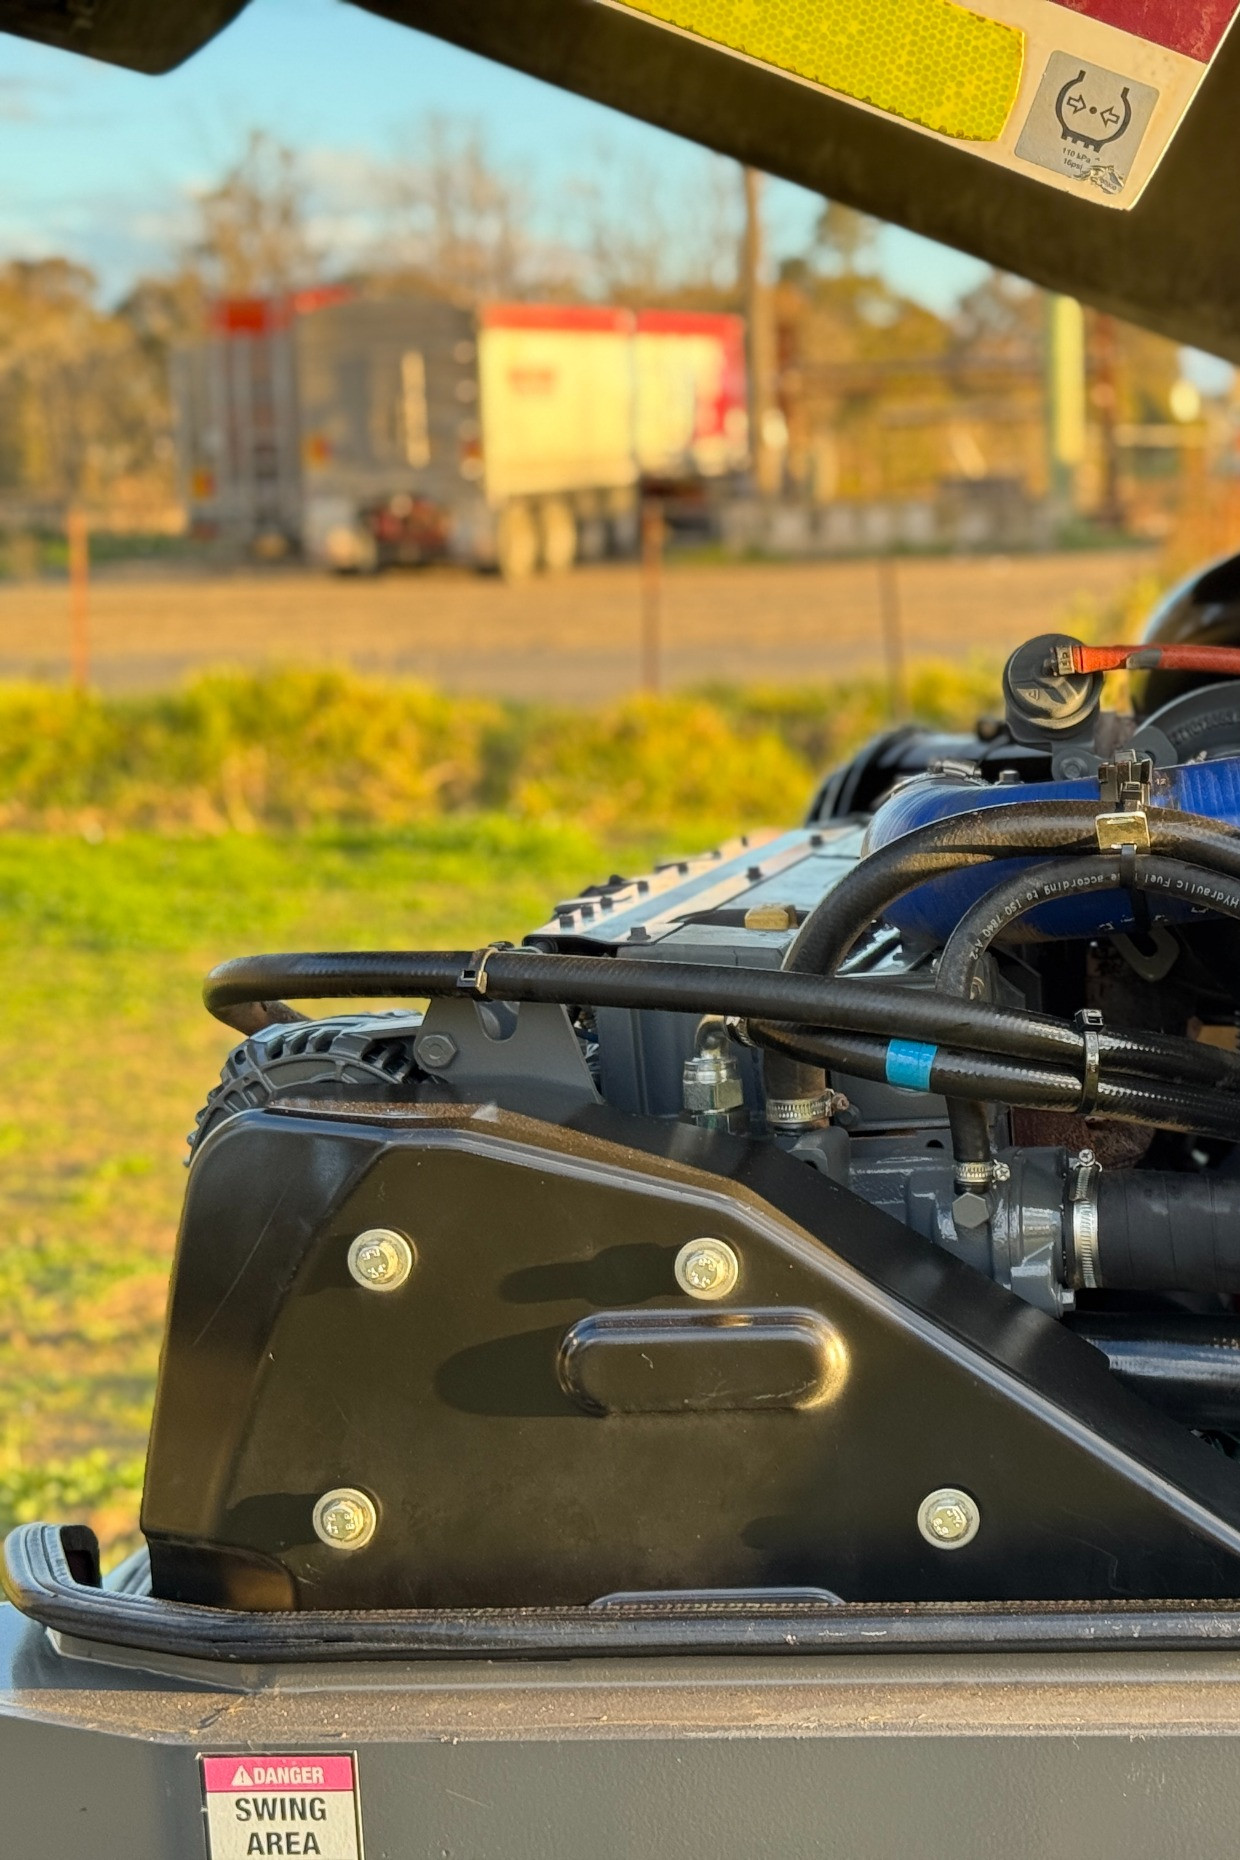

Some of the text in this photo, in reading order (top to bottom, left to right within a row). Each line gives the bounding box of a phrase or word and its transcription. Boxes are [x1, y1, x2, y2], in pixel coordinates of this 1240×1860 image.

[1076, 152, 1091, 163] kPa
[1043, 874, 1104, 896] according
[1145, 873, 1171, 888] Fuel
[1026, 889, 1039, 901] to
[1004, 898, 1023, 916] ISO
[982, 914, 1003, 938] 7840
[253, 1766, 325, 1784] DANGER
[235, 1797, 327, 1822] SWING
[247, 1832, 321, 1856] AREA
